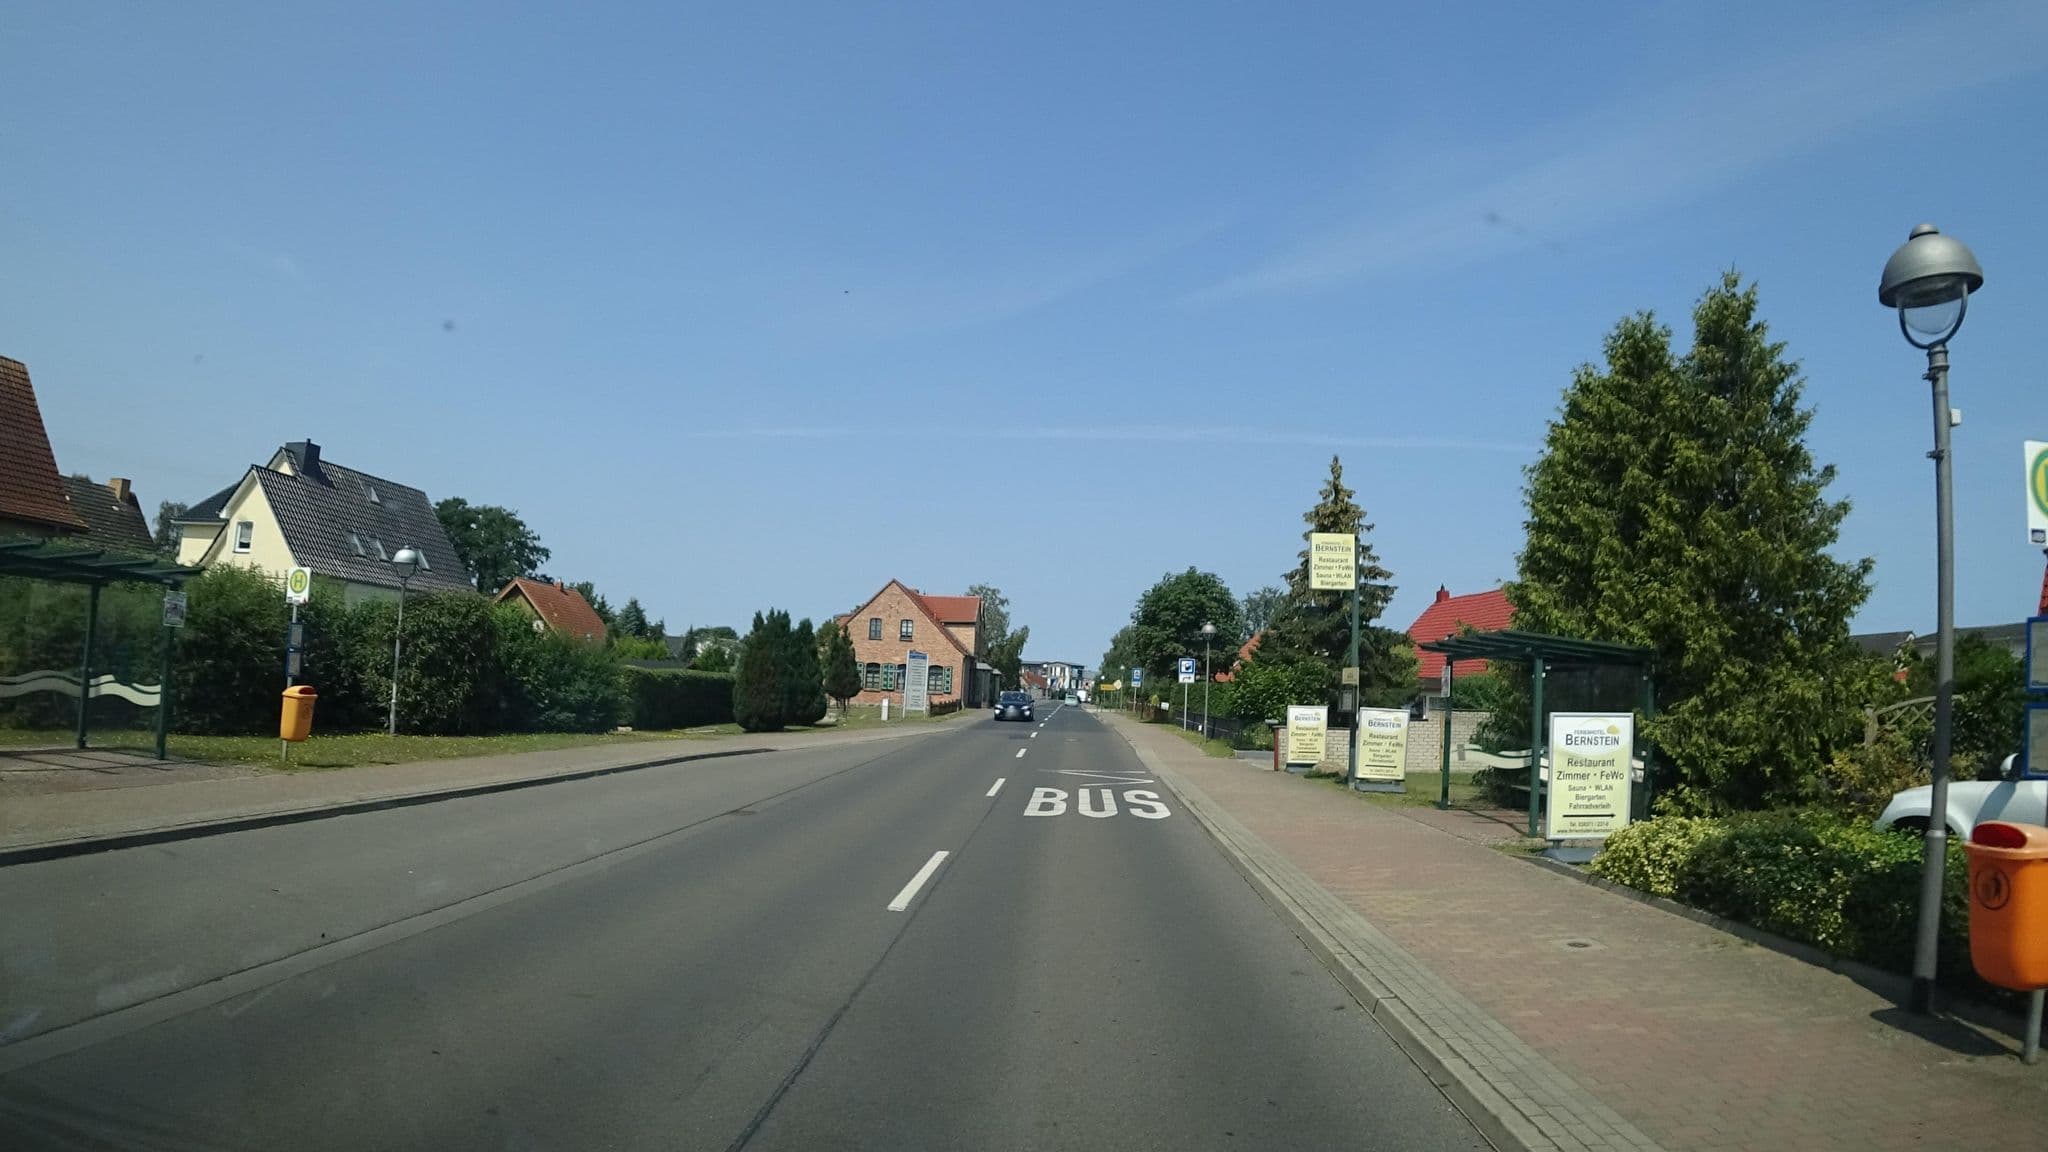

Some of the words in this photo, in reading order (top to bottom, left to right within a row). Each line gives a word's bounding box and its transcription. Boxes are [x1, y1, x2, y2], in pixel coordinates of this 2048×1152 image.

[1315, 543, 1352, 552] BERNSTEIN
[1367, 719, 1402, 729] BERNSTEIN
[1565, 733, 1620, 746] BERNSTEIN
[1567, 757, 1616, 767] Restaurant
[1557, 771, 1591, 780] Zimmer
[1599, 771, 1625, 780] FeWo
[1023, 787, 1171, 819] BUS
[1575, 794, 1606, 802] Biergarten
